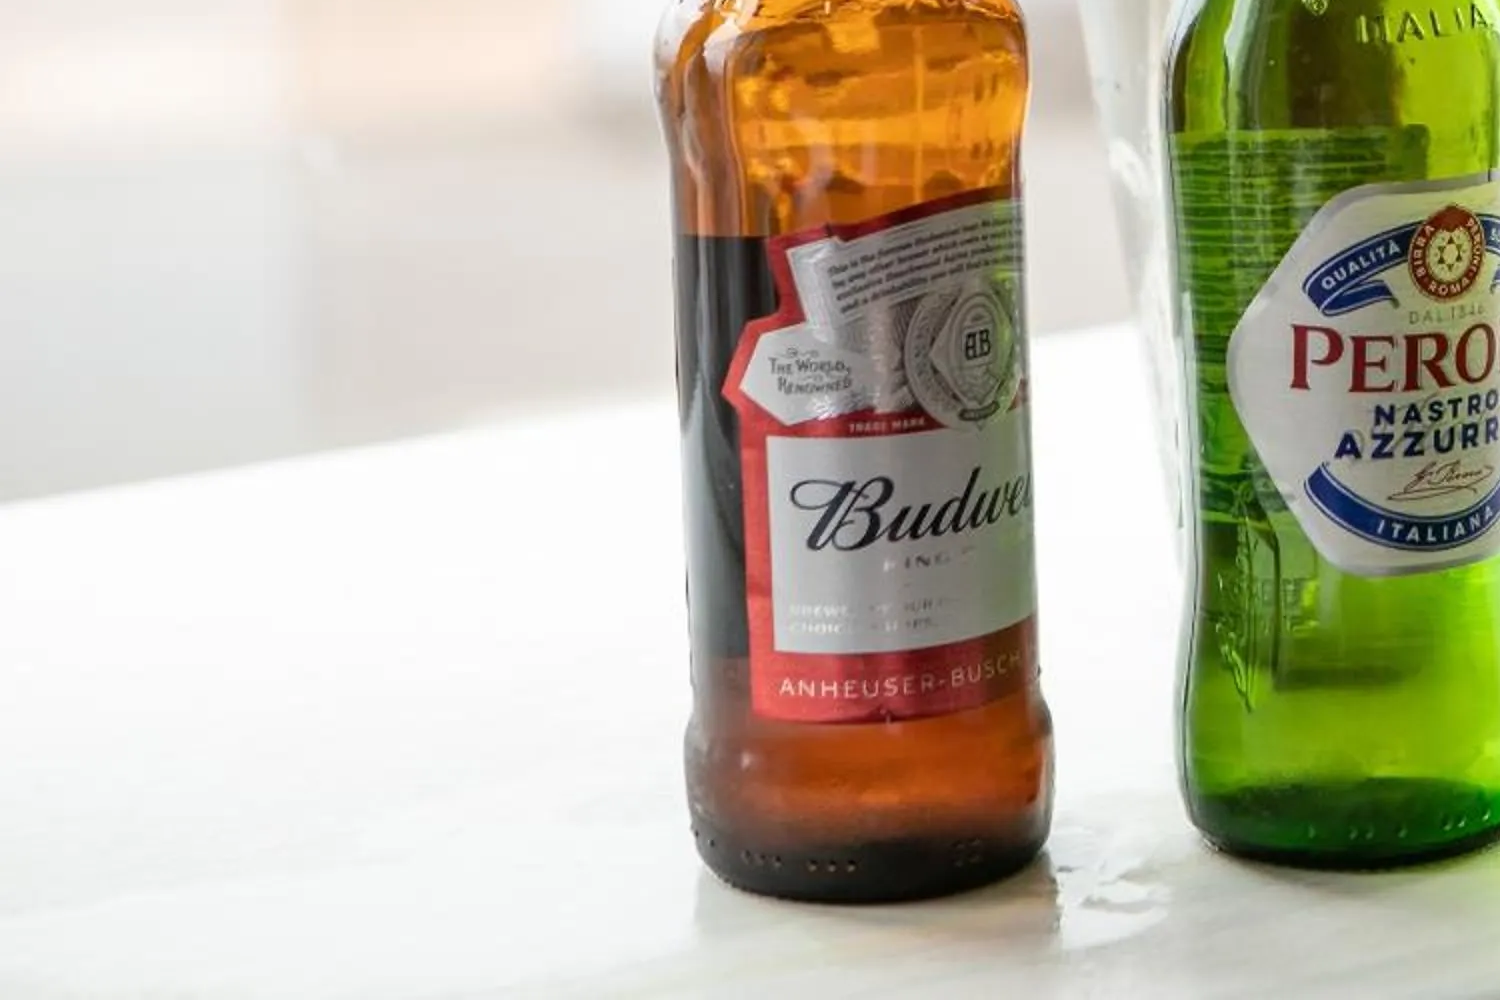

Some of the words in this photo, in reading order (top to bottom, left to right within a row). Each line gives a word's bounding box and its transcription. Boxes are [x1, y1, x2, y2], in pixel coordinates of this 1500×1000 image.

[1427, 278, 1470, 296] ROMA
[1374, 388, 1499, 426] NASTRO
[1375, 506, 1494, 543] ITALIANA
[779, 652, 1022, 699] ANHEUSER-BUSCH
